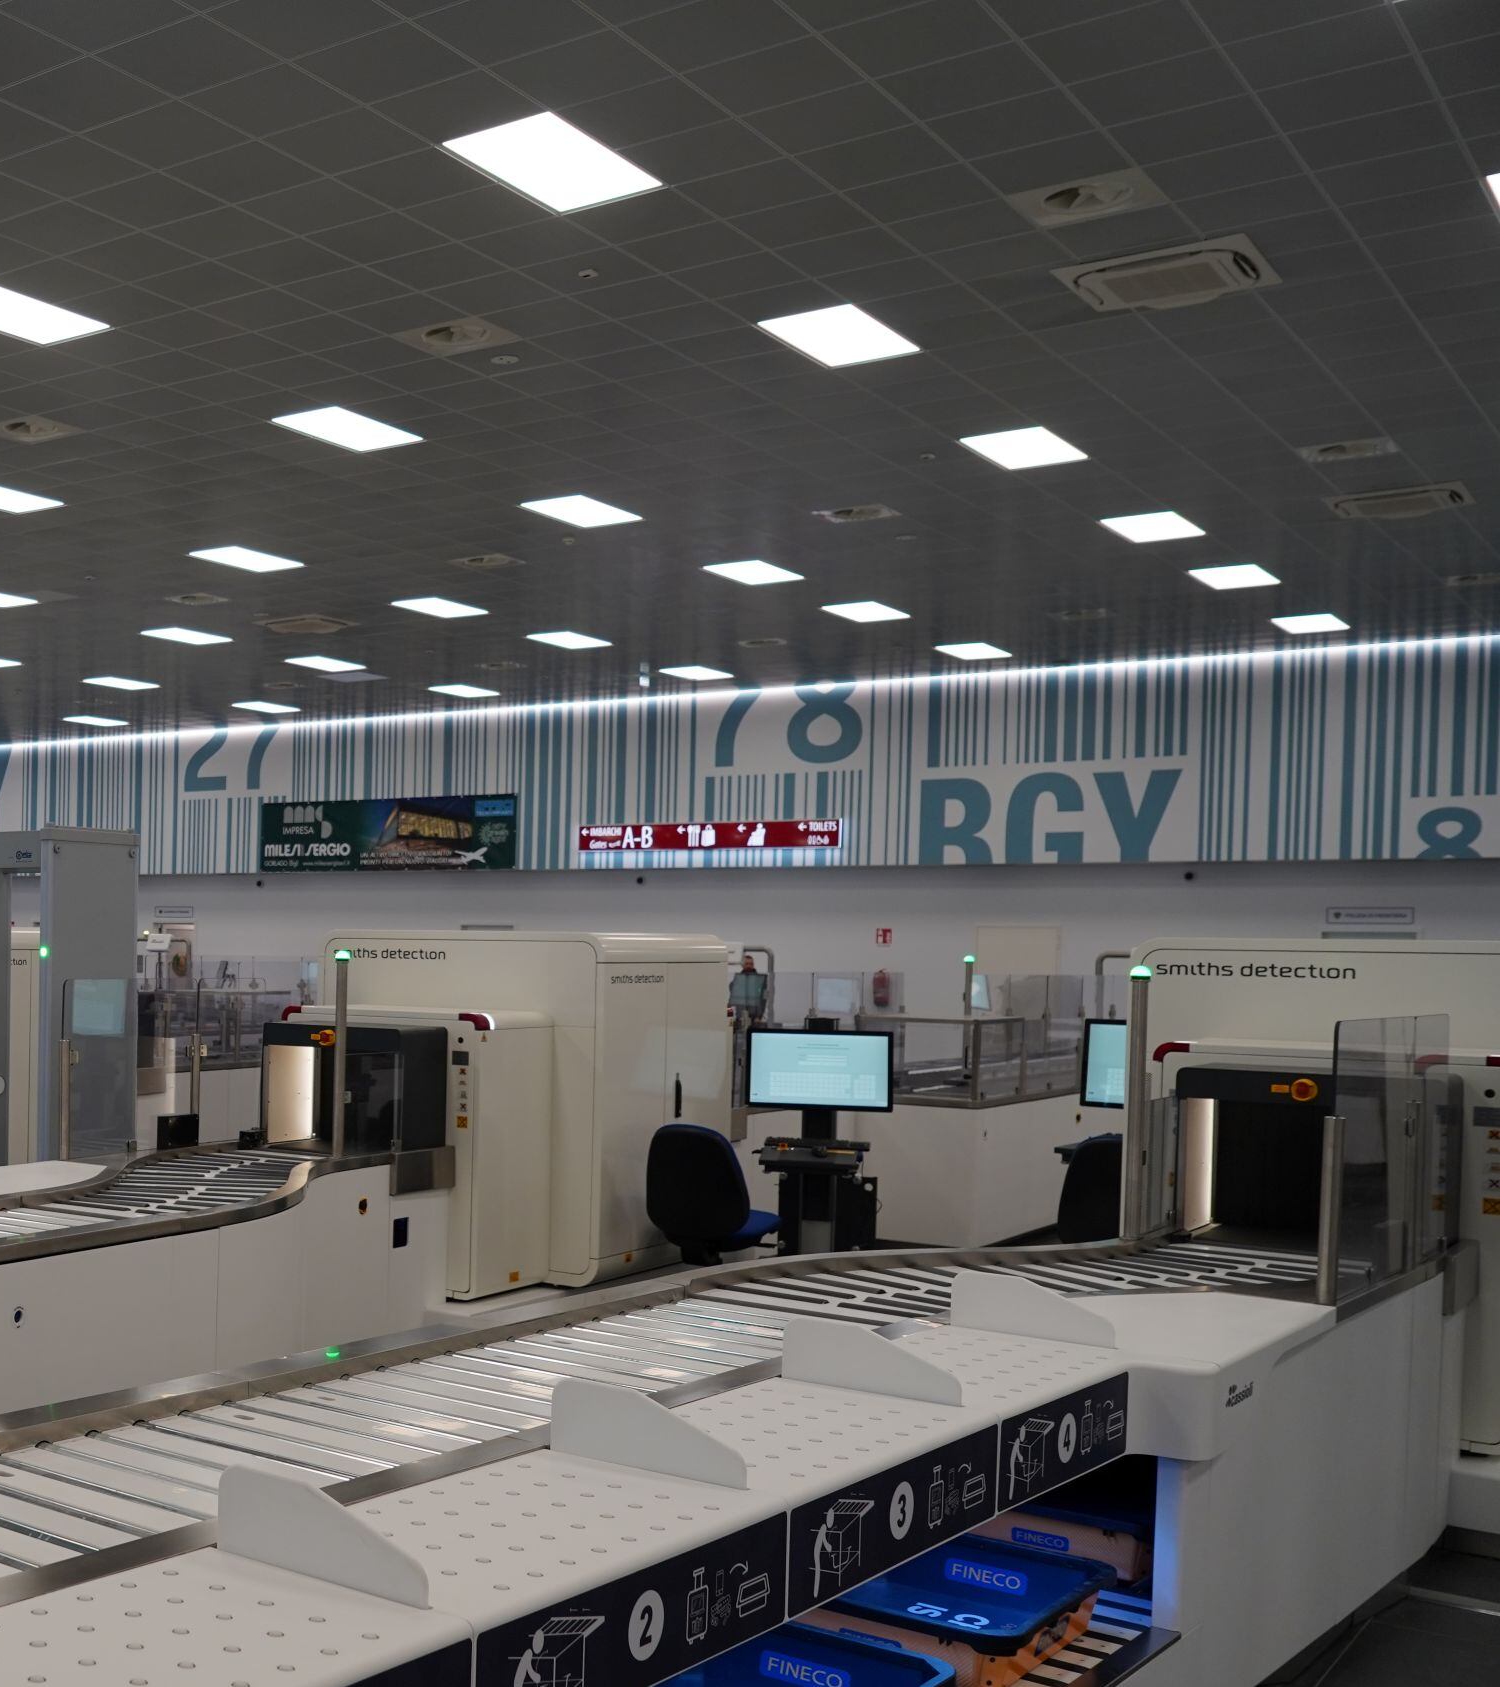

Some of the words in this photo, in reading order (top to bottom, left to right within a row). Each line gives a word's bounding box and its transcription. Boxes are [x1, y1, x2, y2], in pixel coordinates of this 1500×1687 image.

[808, 820, 838, 832] TOILETS
[918, 769, 1183, 864] BGY
[282, 826, 314, 835] IMPRESA
[589, 826, 622, 837] IMBARCHI
[621, 825, 654, 849] A-B
[264, 843, 301, 857] MILESI
[304, 842, 351, 857] SERGIO
[381, 947, 446, 960] detection
[611, 974, 634, 985] smiths
[634, 973, 665, 984] detection
[1156, 961, 1234, 977] smiths
[1240, 963, 1357, 980] detection
[1062, 1428, 1072, 1453] 4
[896, 1496, 908, 1528] 3
[1016, 1530, 1065, 1549] FINECO
[951, 1563, 1021, 1590] FINECO
[639, 1605, 655, 1648] 2
[767, 1656, 843, 1687] FINECO
